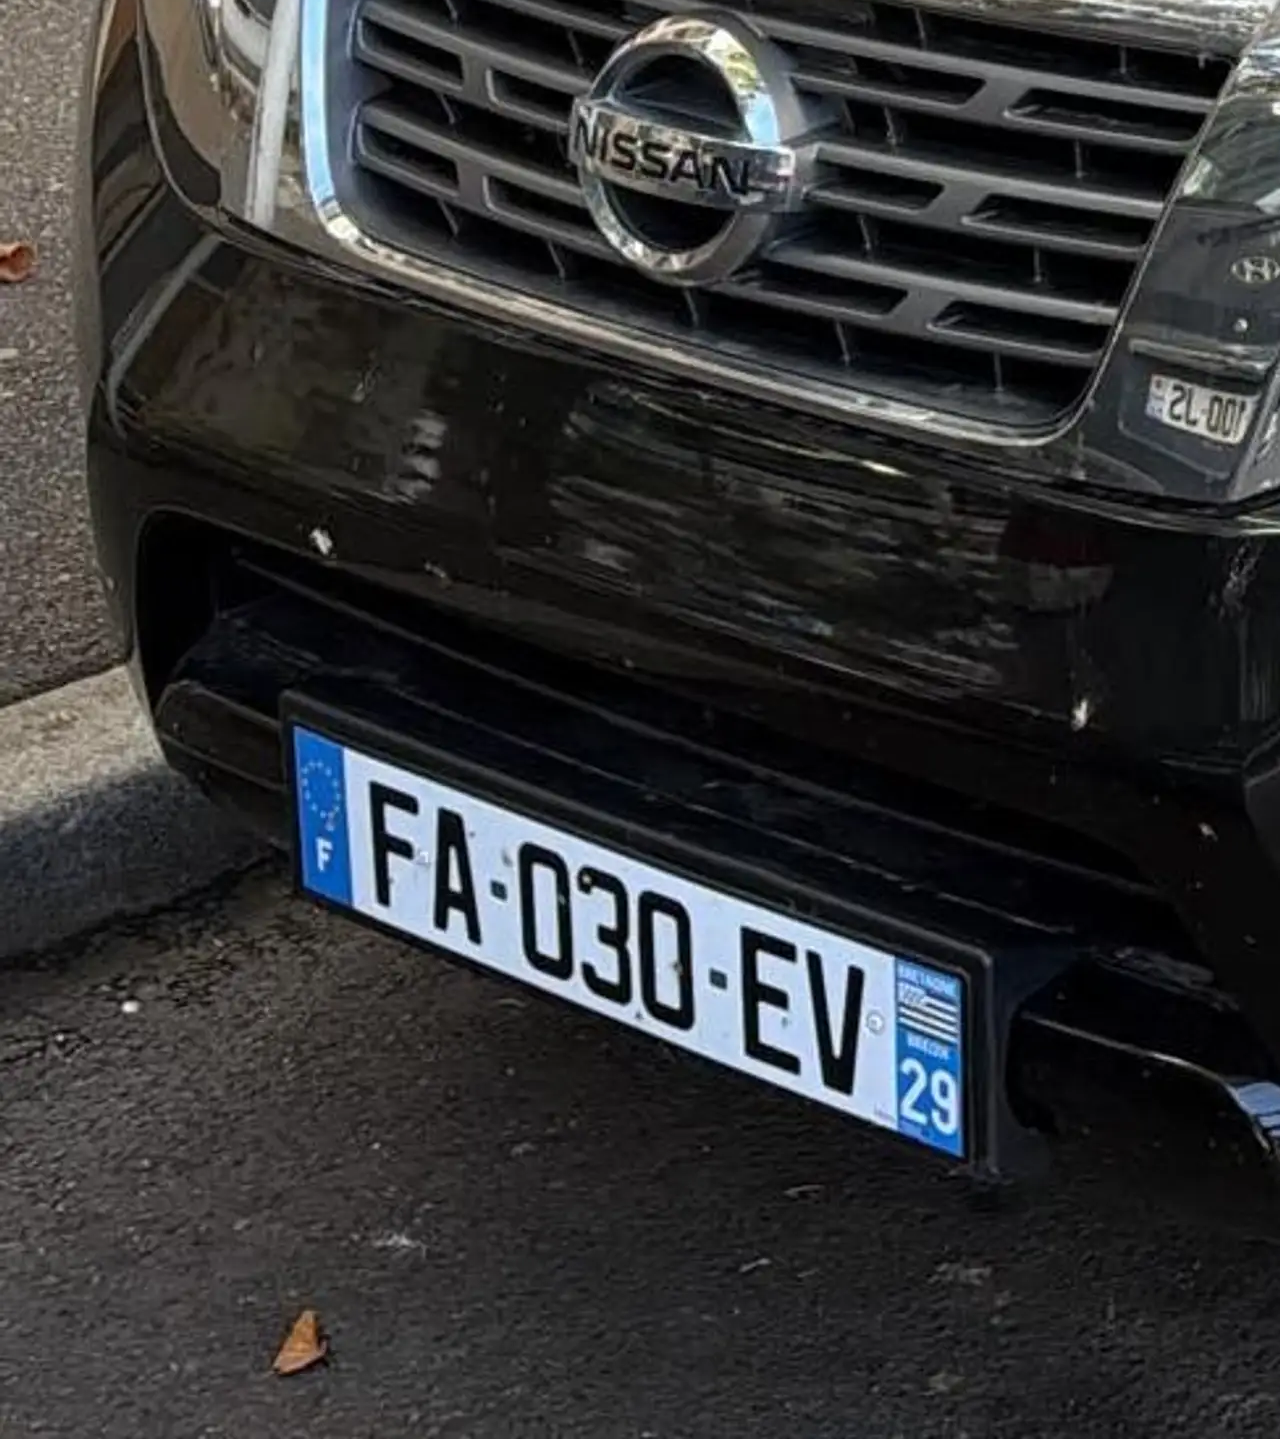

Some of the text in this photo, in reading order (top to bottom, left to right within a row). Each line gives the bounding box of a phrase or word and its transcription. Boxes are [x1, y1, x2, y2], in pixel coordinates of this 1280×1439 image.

[575, 116, 752, 196] NISSAN
[315, 837, 334, 872] F
[369, 780, 865, 1095] FA-030-EV
[900, 1057, 958, 1135] 29
